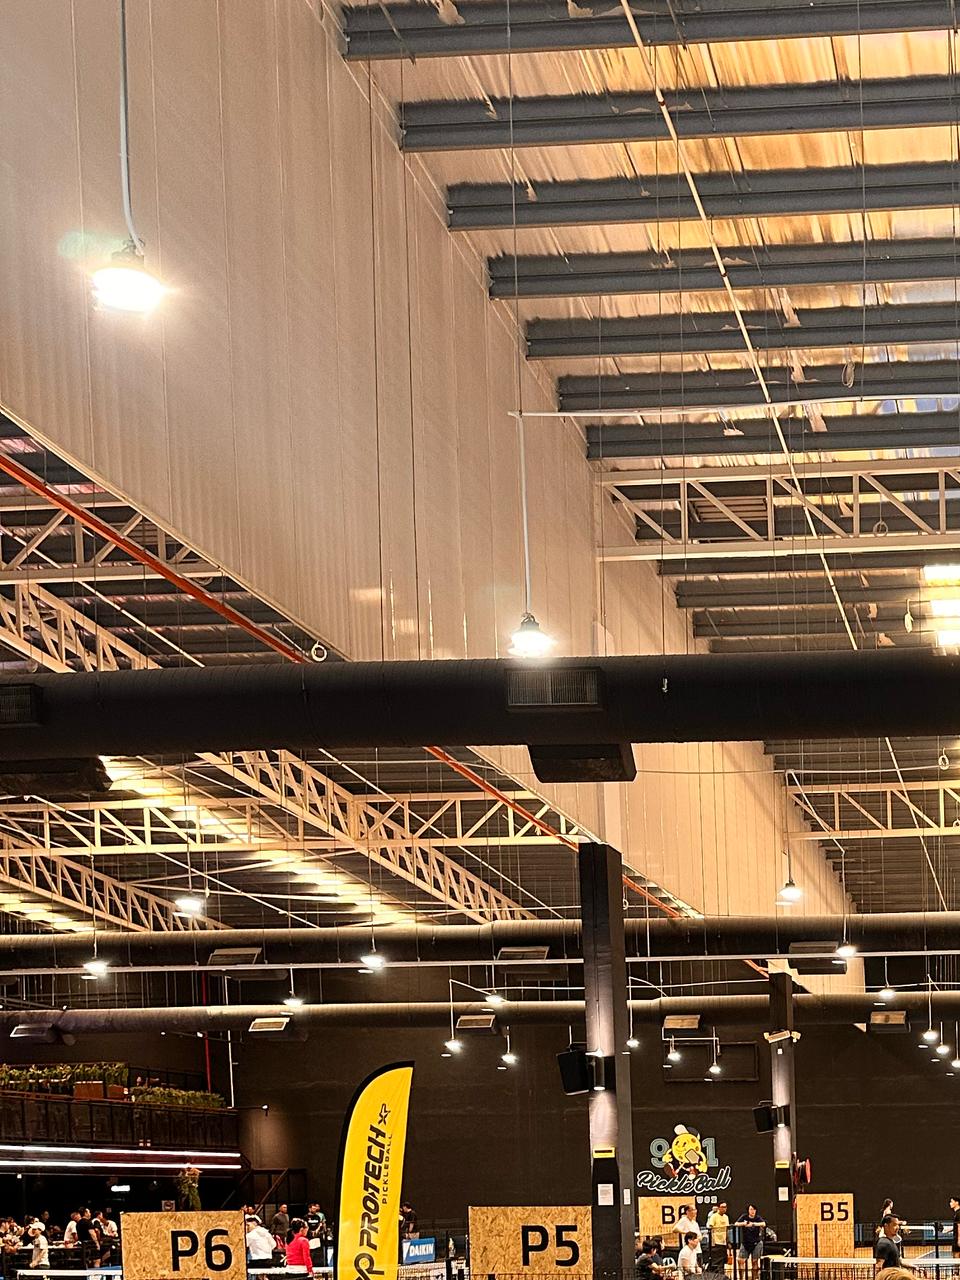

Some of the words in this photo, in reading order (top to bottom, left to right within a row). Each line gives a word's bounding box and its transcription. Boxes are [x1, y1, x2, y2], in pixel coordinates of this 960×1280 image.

[359, 1124, 387, 1250] PROTECH
[382, 1133, 393, 1205] PICKLEBALL
[820, 1202, 849, 1222] B5
[171, 1228, 233, 1271] P6
[409, 1243, 434, 1256] DAIKIN
[521, 1225, 580, 1267] P5
